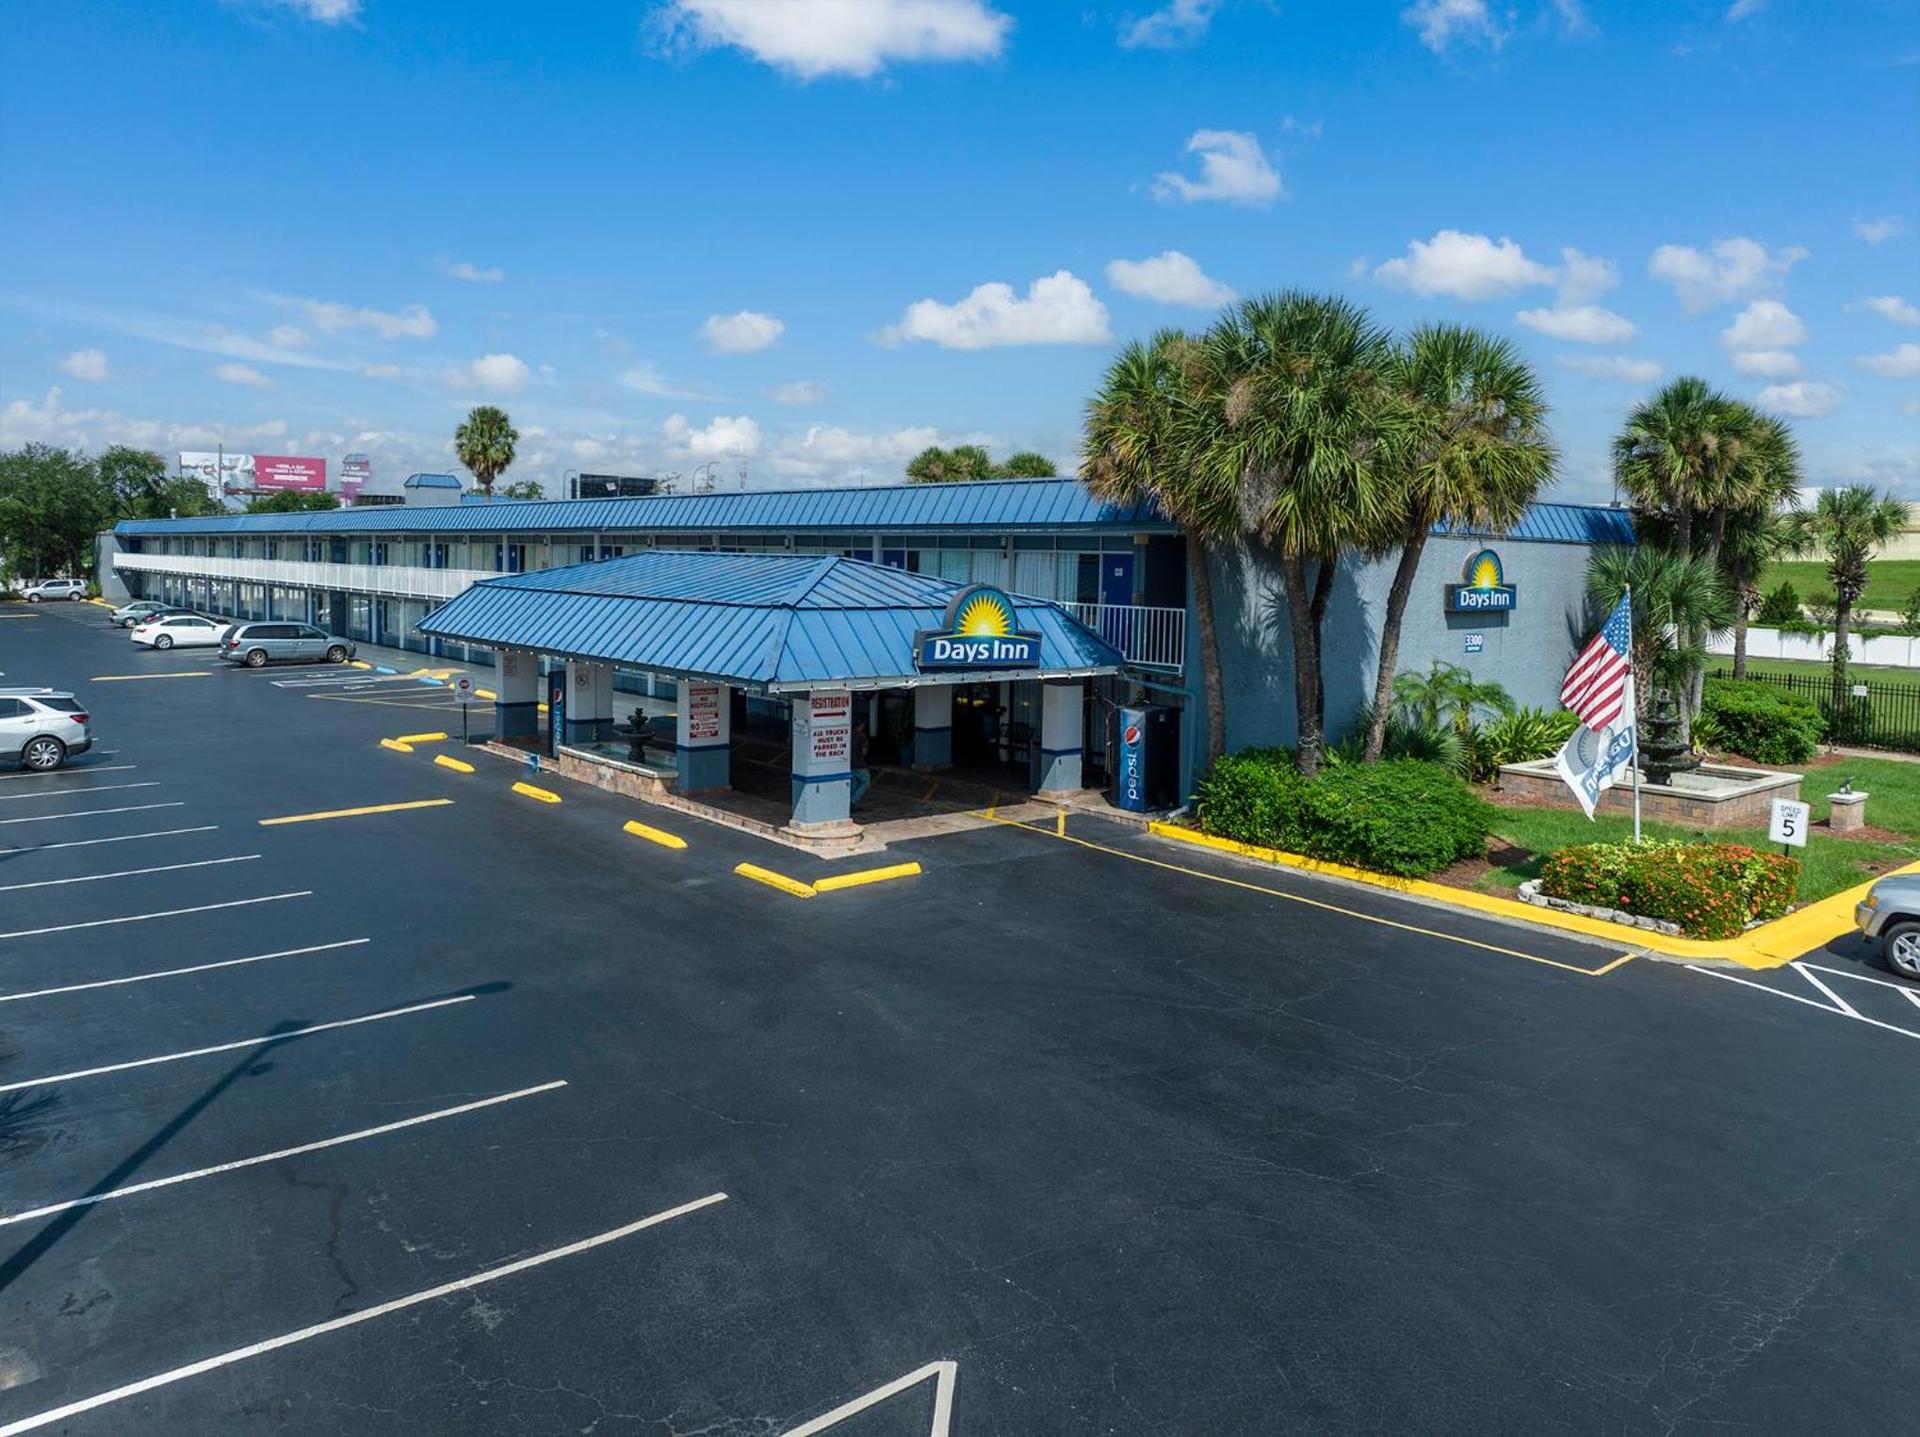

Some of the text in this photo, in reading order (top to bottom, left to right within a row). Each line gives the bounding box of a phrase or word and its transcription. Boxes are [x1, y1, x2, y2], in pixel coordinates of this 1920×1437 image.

[1460, 591, 1510, 608] Days Inn
[1465, 634, 1483, 646] 3300
[934, 640, 1029, 663] Days Inn
[811, 696, 849, 709] REGISTRATION
[1126, 753, 1139, 800] pepsi
[1780, 804, 1802, 815] SPEED
[1781, 811, 1799, 819] LIMIT
[1782, 819, 1795, 837] 5
